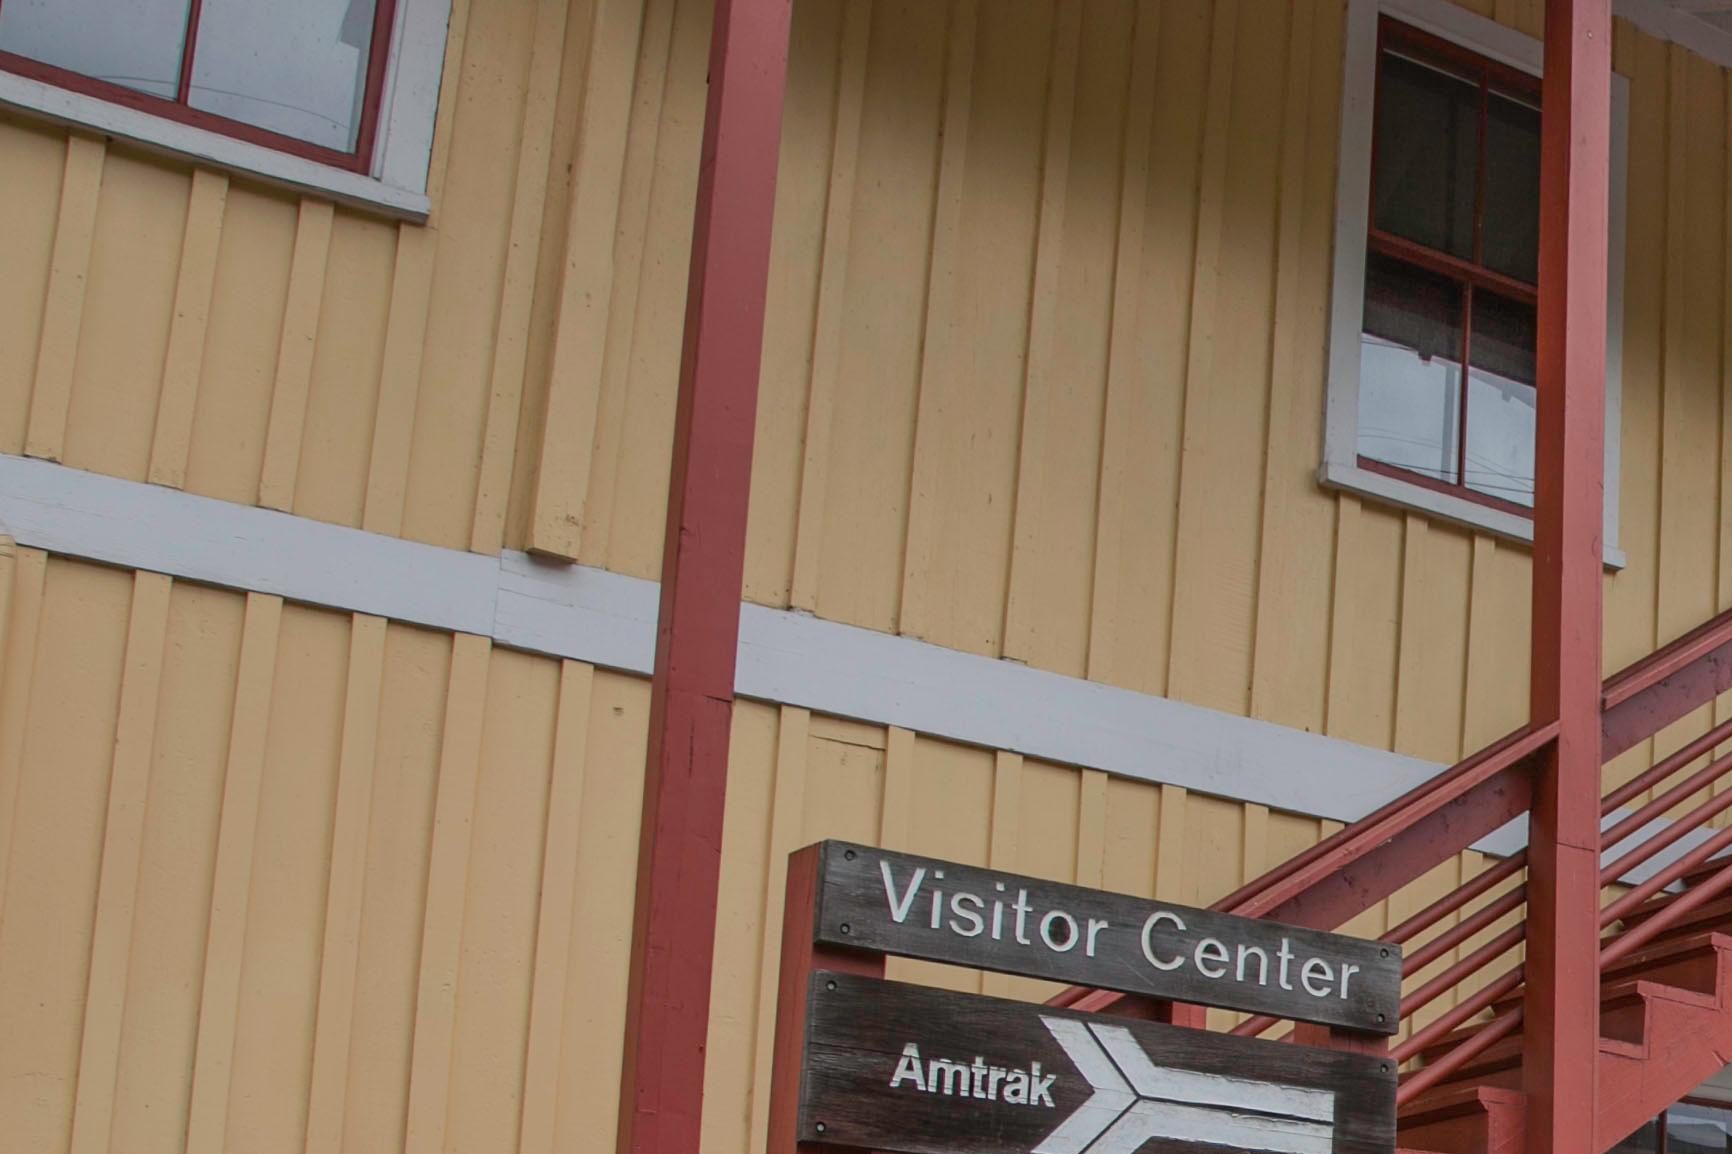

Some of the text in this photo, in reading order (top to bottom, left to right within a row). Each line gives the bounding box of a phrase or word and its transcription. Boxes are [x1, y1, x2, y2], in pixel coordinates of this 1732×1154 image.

[879, 859, 1361, 1000] Visitor Center
[888, 1042, 1057, 1108] Amtrak
